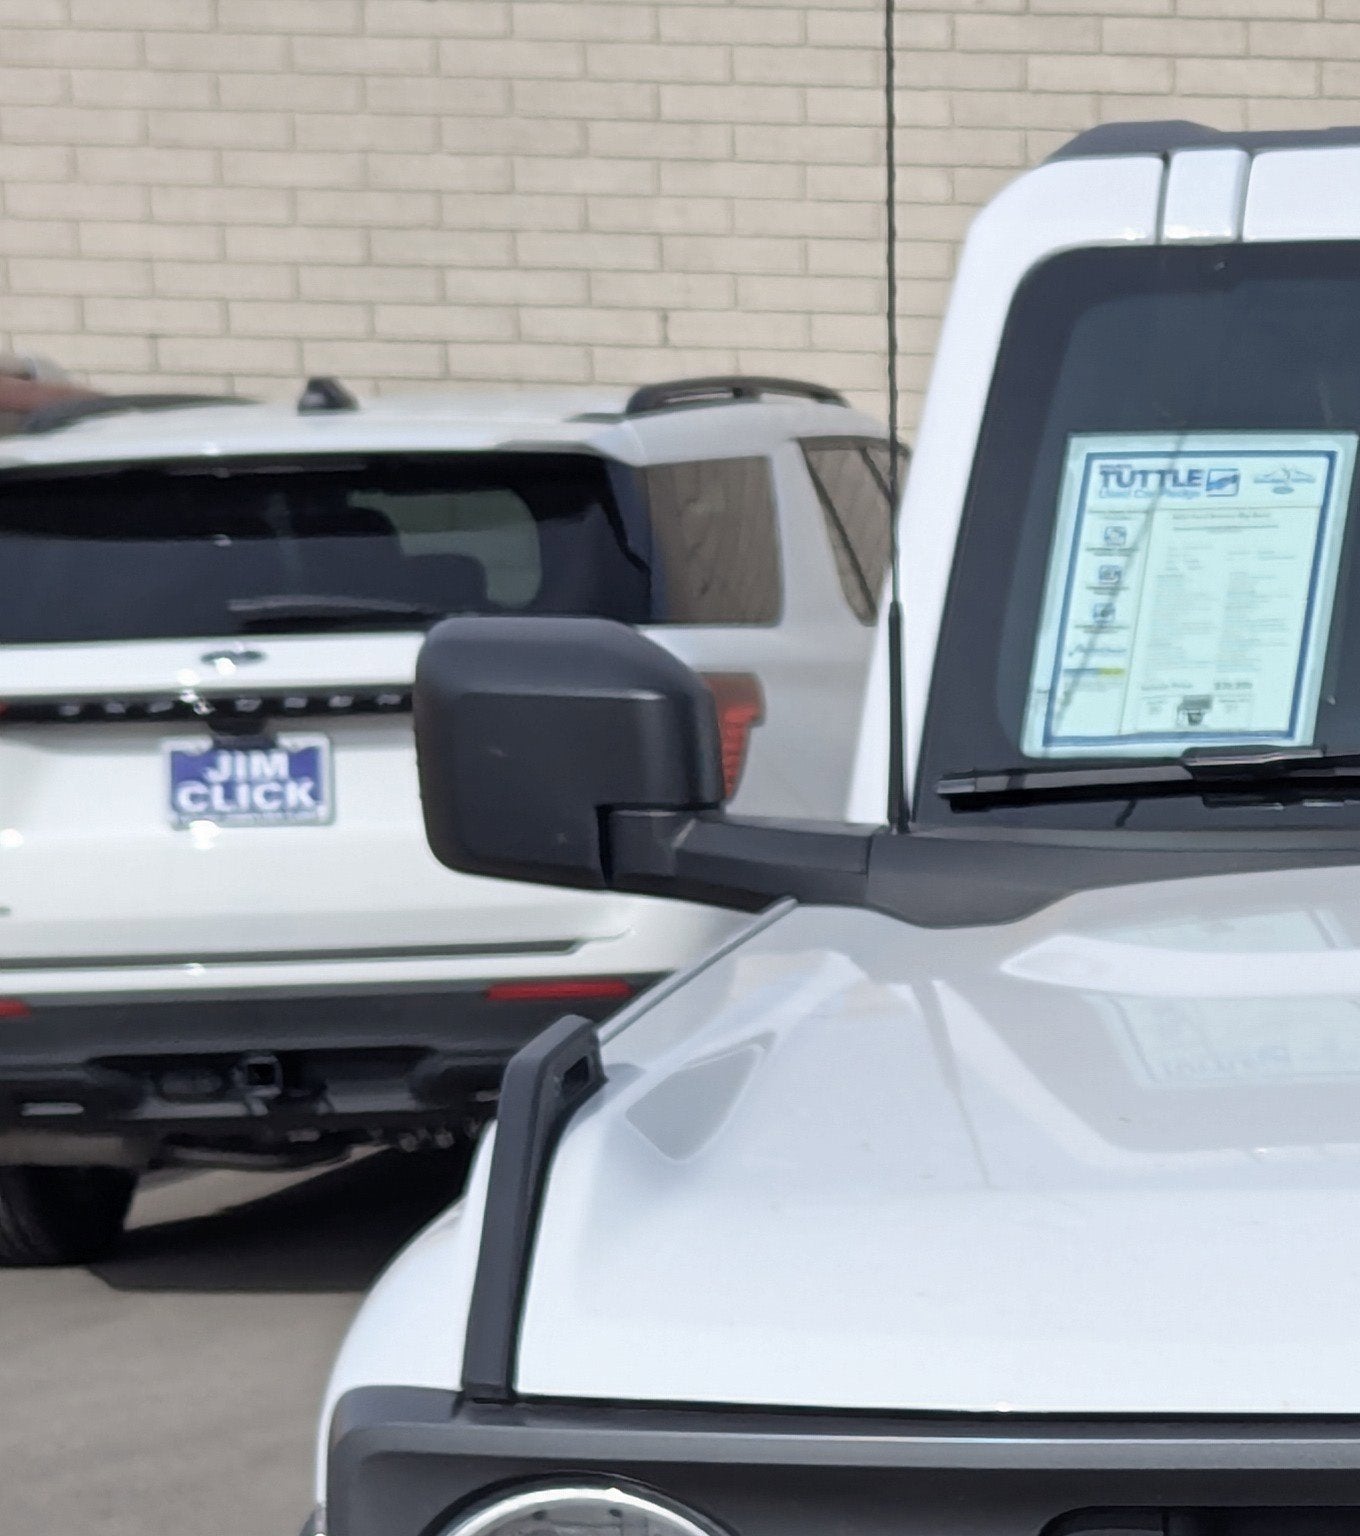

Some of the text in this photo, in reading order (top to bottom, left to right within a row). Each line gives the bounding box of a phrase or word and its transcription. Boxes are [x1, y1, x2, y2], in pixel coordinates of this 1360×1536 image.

[1100, 468, 1204, 488] TUTTLE
[203, 750, 291, 783] JIM
[176, 778, 316, 813] CLICK
